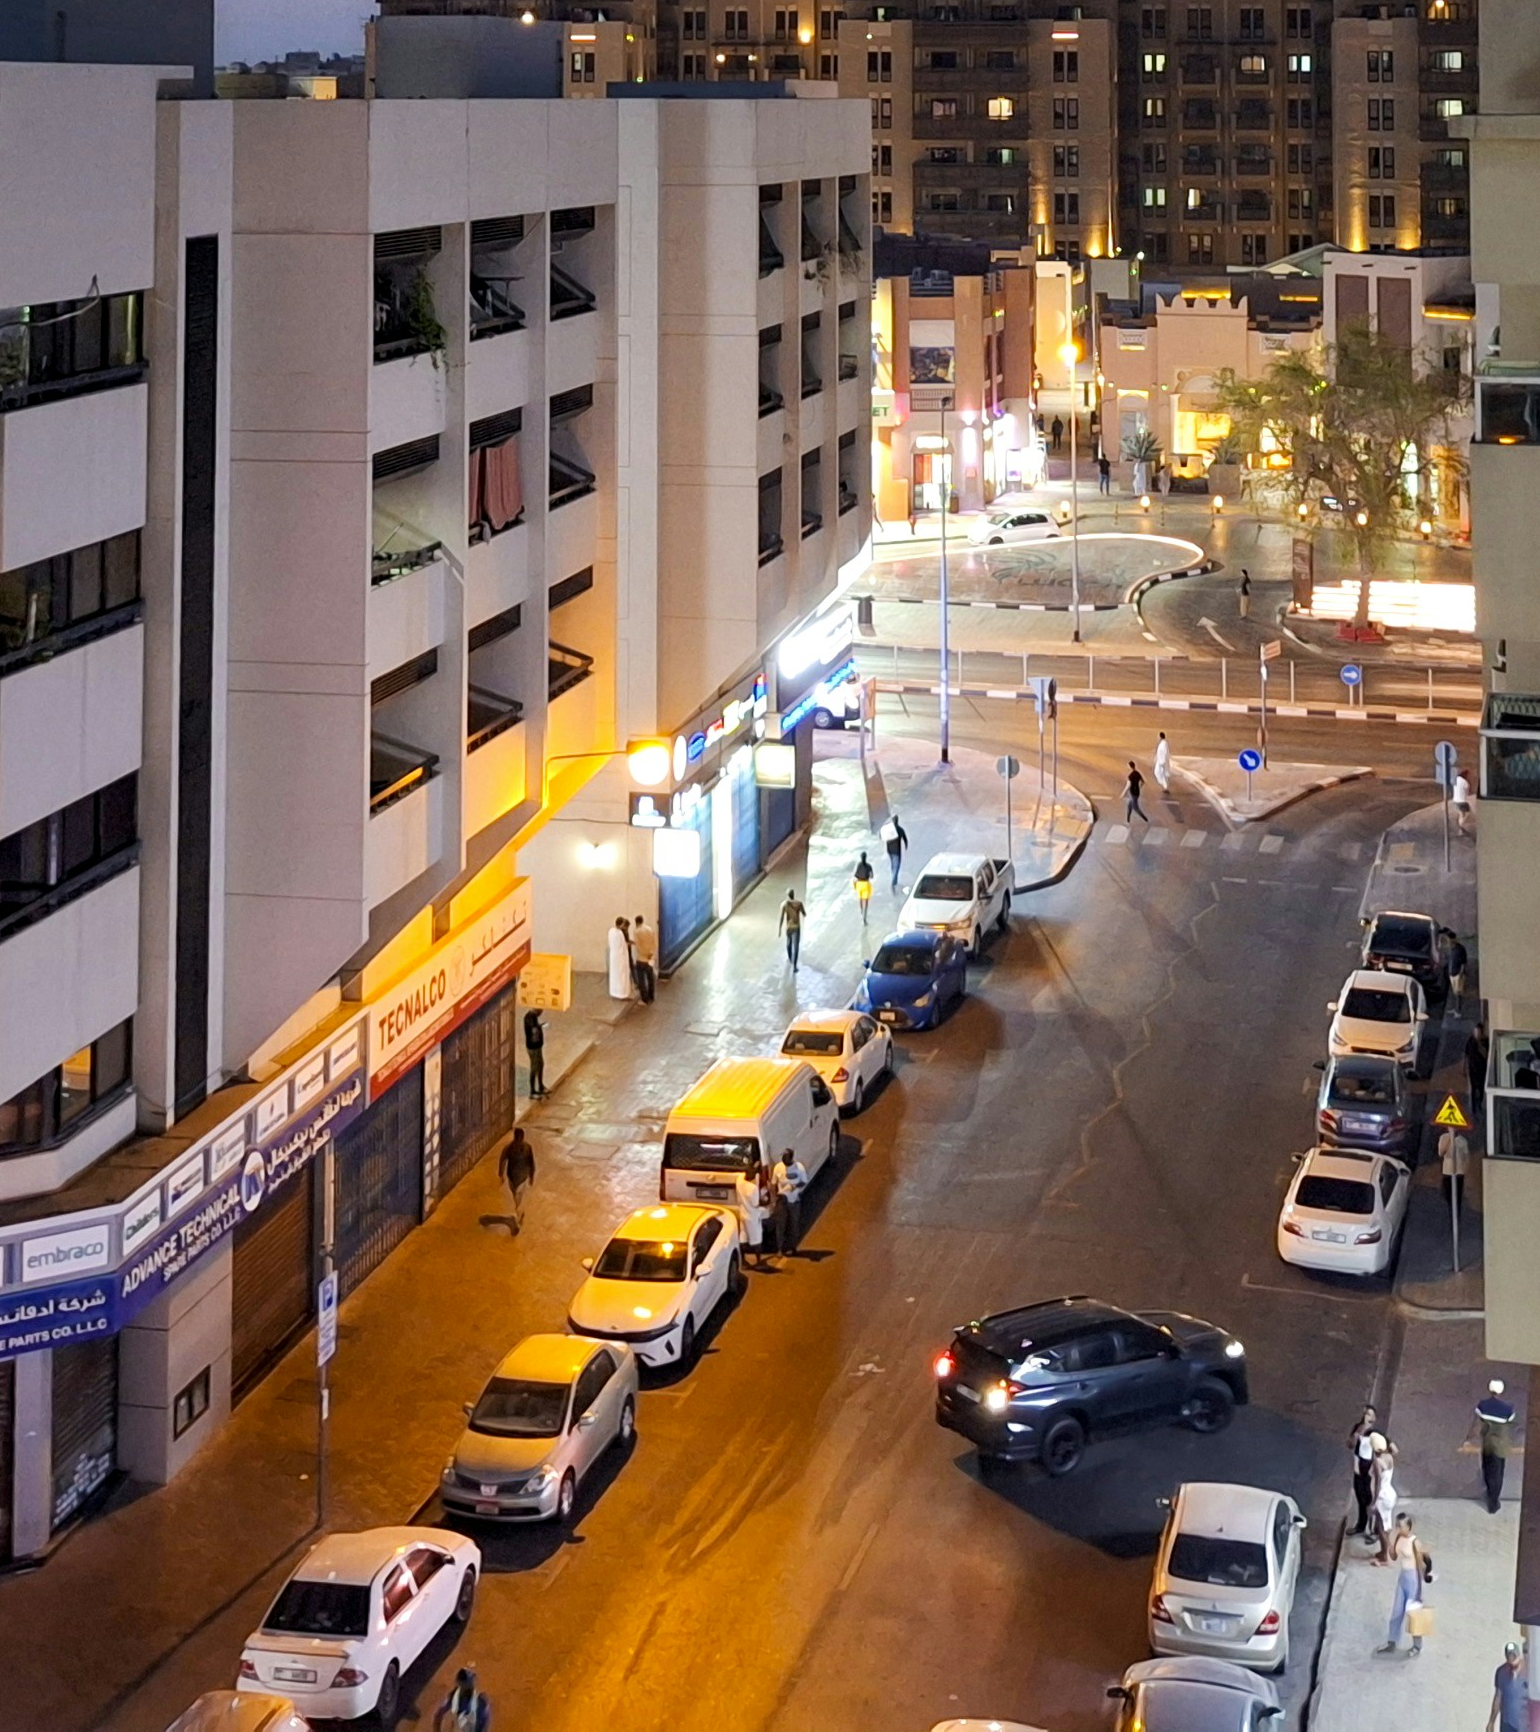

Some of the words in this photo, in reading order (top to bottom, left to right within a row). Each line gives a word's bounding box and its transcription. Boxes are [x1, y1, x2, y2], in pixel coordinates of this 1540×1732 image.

[379, 968, 446, 1051] TECNALCO
[27, 1242, 104, 1269] embraco
[122, 1234, 178, 1298] ADVANCE
[179, 1184, 241, 1248] TECHNICAL
[164, 1251, 187, 1282] SPARE
[188, 1234, 210, 1260] PARTS
[58, 1289, 106, 1312] شركة
[9, 1328, 50, 1349] PARTS
